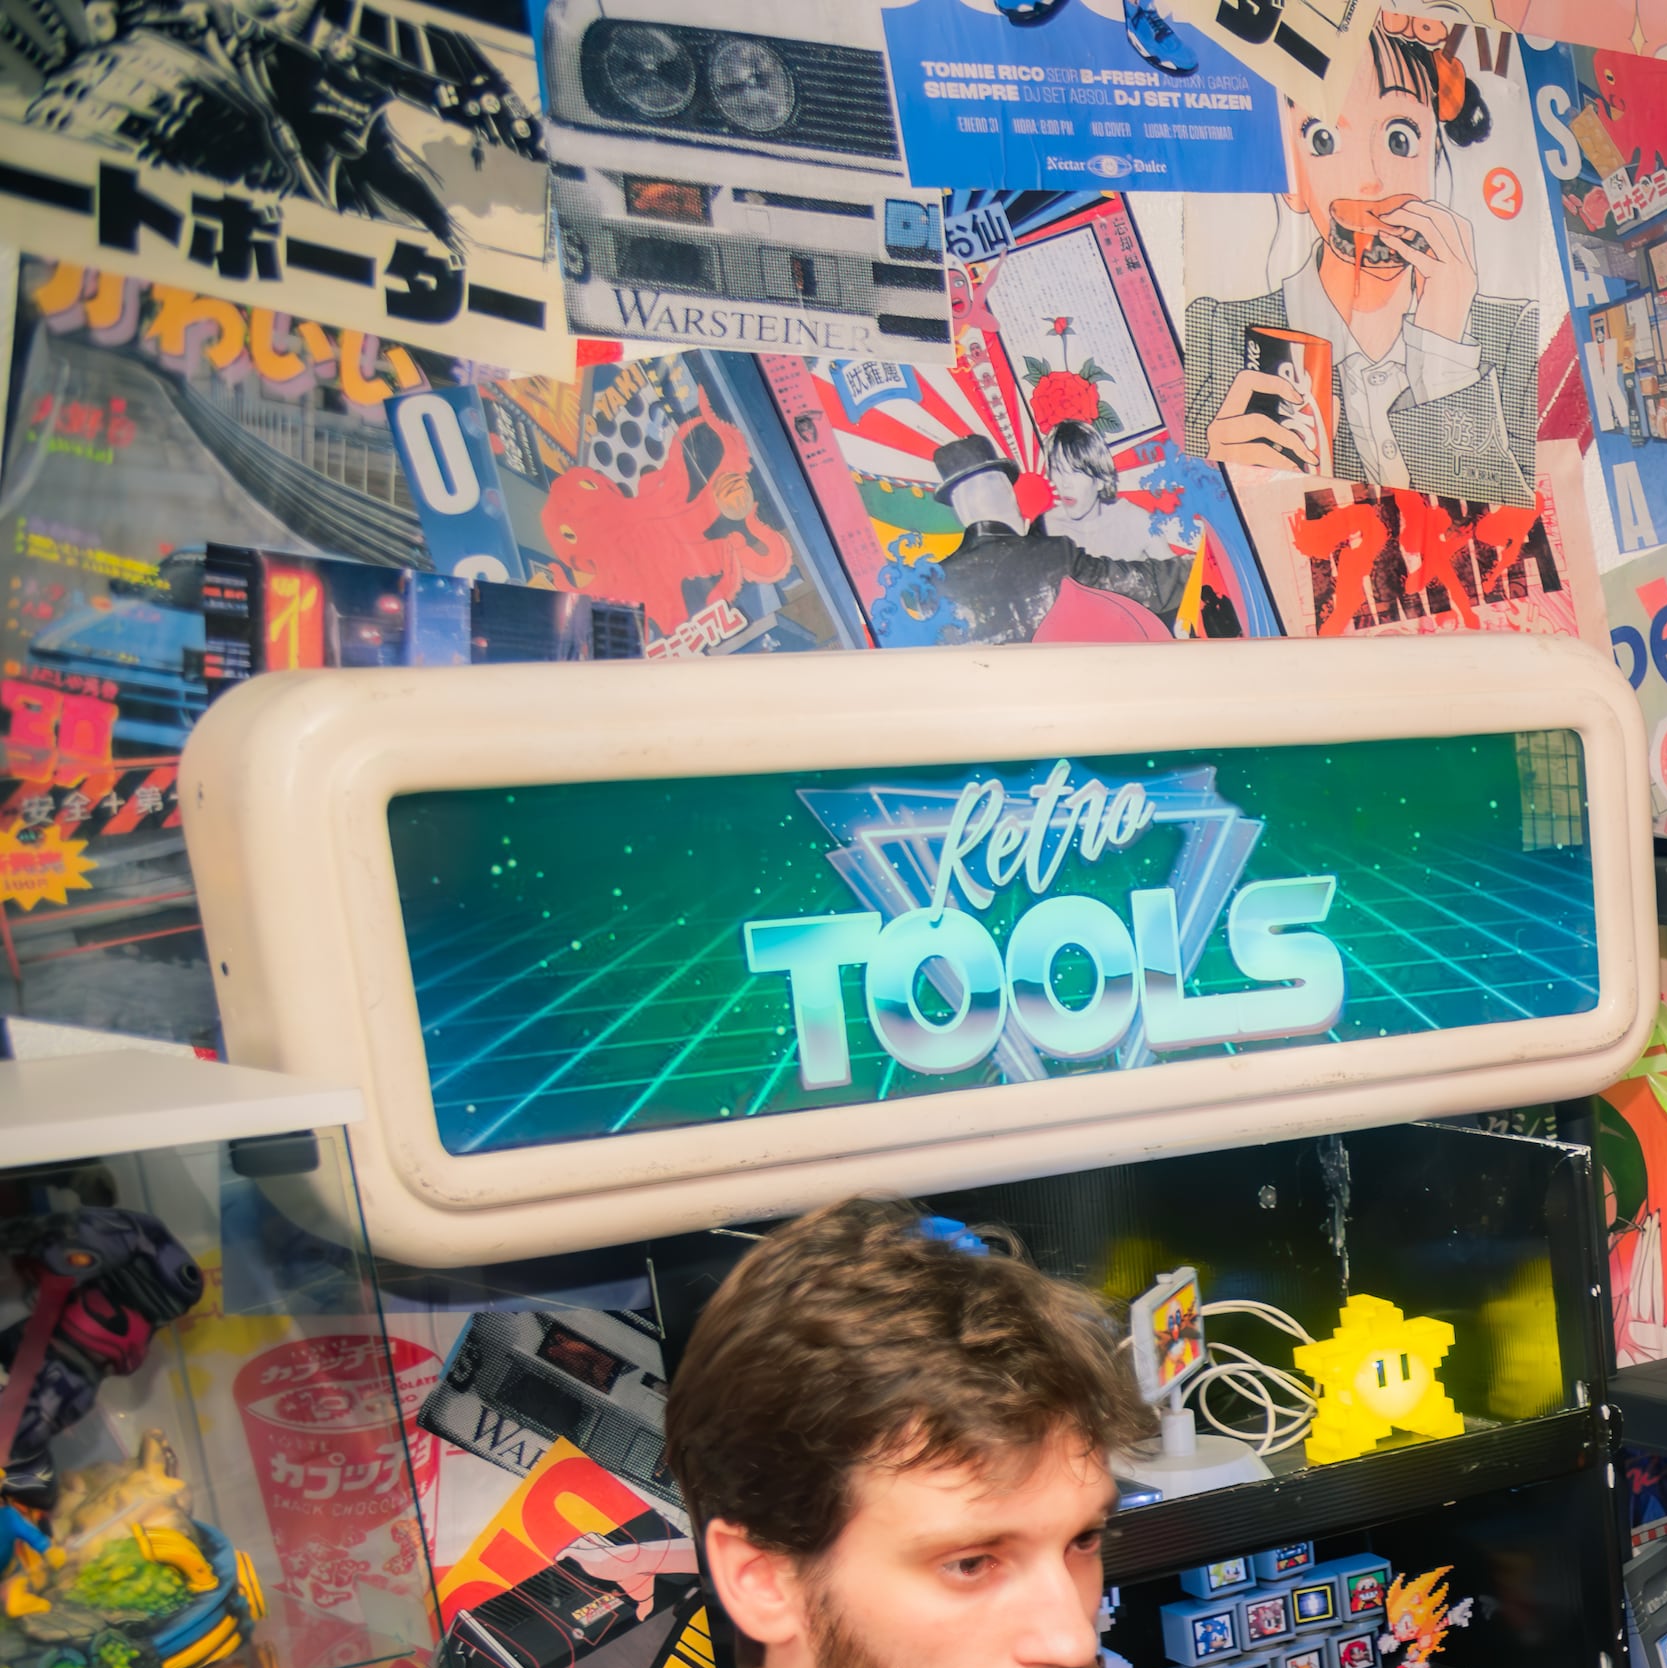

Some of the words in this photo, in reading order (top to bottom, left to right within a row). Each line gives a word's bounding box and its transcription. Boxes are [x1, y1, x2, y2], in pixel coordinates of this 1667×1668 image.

[921, 61, 995, 80] TONNIE
[998, 64, 1044, 82] RICO
[1081, 68, 1159, 87] B-FRESH
[923, 82, 1020, 102] SIEMPRE
[1043, 89, 1069, 104] SET
[1114, 90, 1140, 107] DJ
[1144, 91, 1183, 108] SET
[1185, 92, 1253, 111] KAIZEN
[1489, 176, 1517, 213] 2
[614, 288, 876, 353] WARSTEINER
[929, 758, 1156, 922] Retro
[743, 875, 1347, 1091] TOOLS
